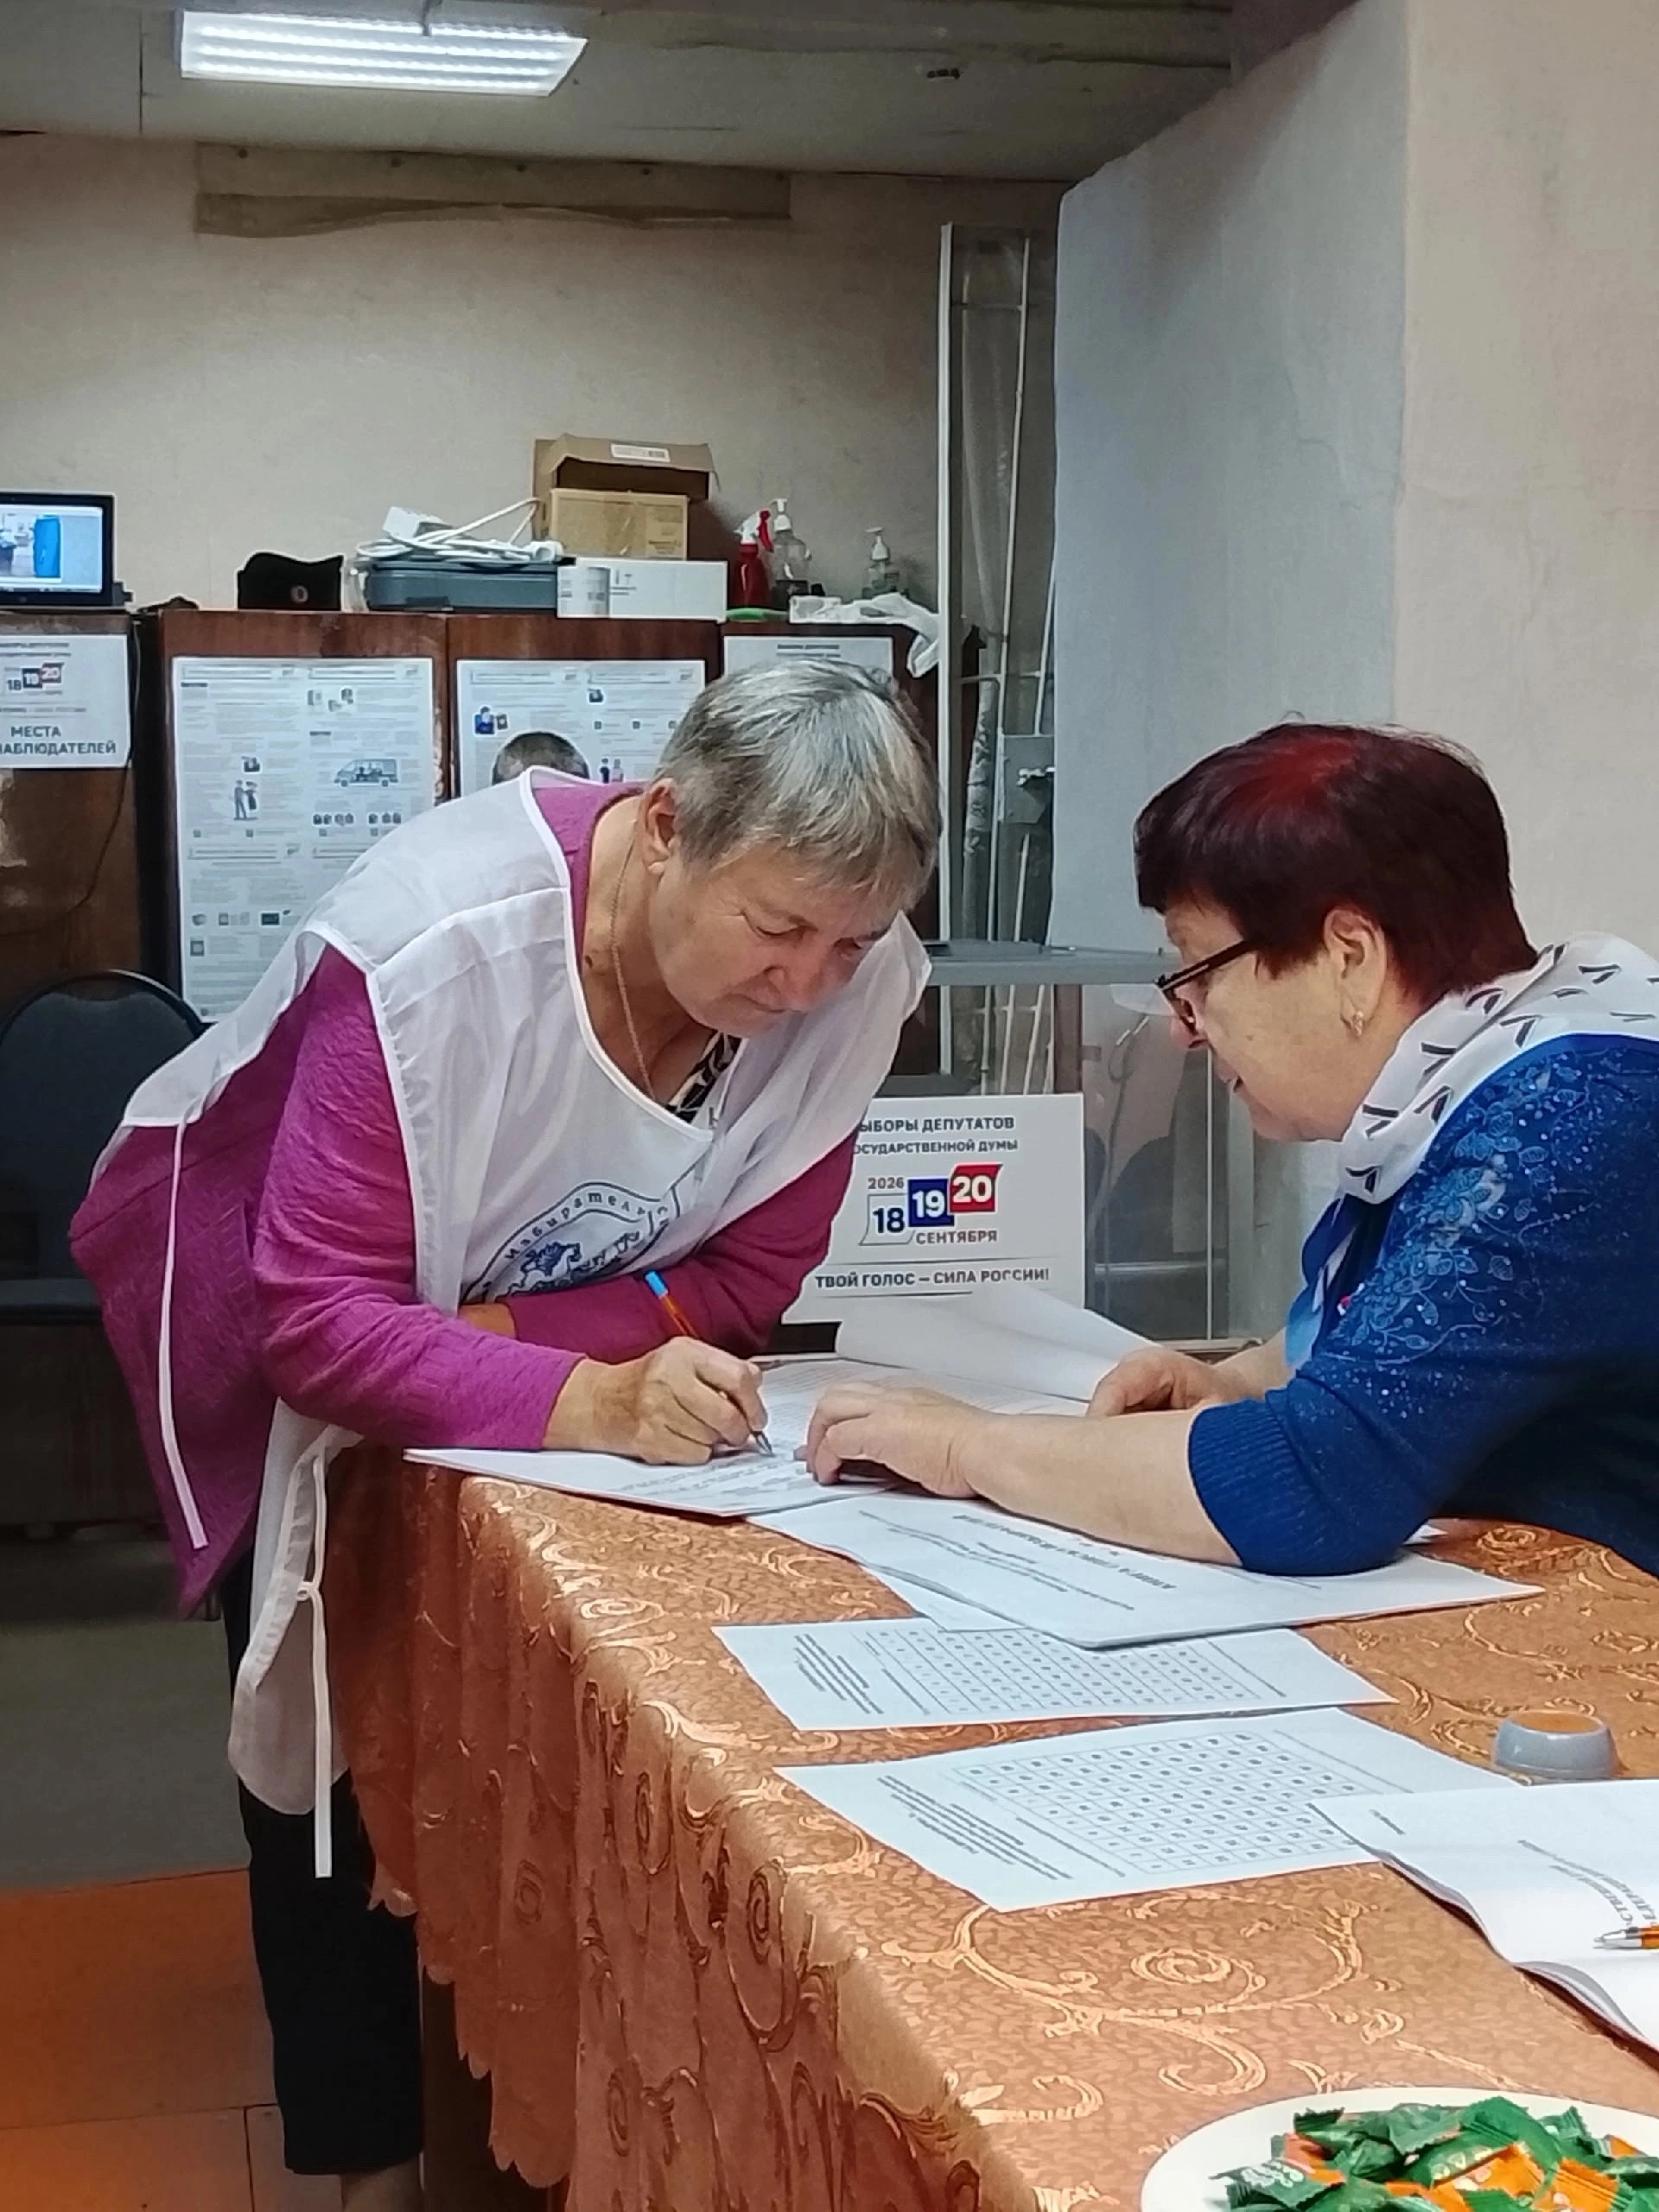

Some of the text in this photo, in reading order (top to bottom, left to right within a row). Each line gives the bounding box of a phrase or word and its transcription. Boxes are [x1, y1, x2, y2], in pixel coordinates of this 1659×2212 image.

[10, 726, 61, 737] МЕСТА
[858, 1116, 1014, 1133] ЫБОРЫ ДЕПУТАТОВ
[854, 1138, 1018, 1155] ОСУДАРСТВЕННОЙ ДУМЫ
[868, 1177, 905, 1190] 2026
[872, 1175, 993, 1234] 18 19 20
[915, 1230, 998, 1245] СЕНТЯБРЯ
[815, 1271, 859, 1288] ТВОЙ
[862, 1272, 916, 1287] ГОЛОС
[933, 1270, 976, 1284] СИЛА
[981, 1268, 1050, 1283] РОССИИ!
